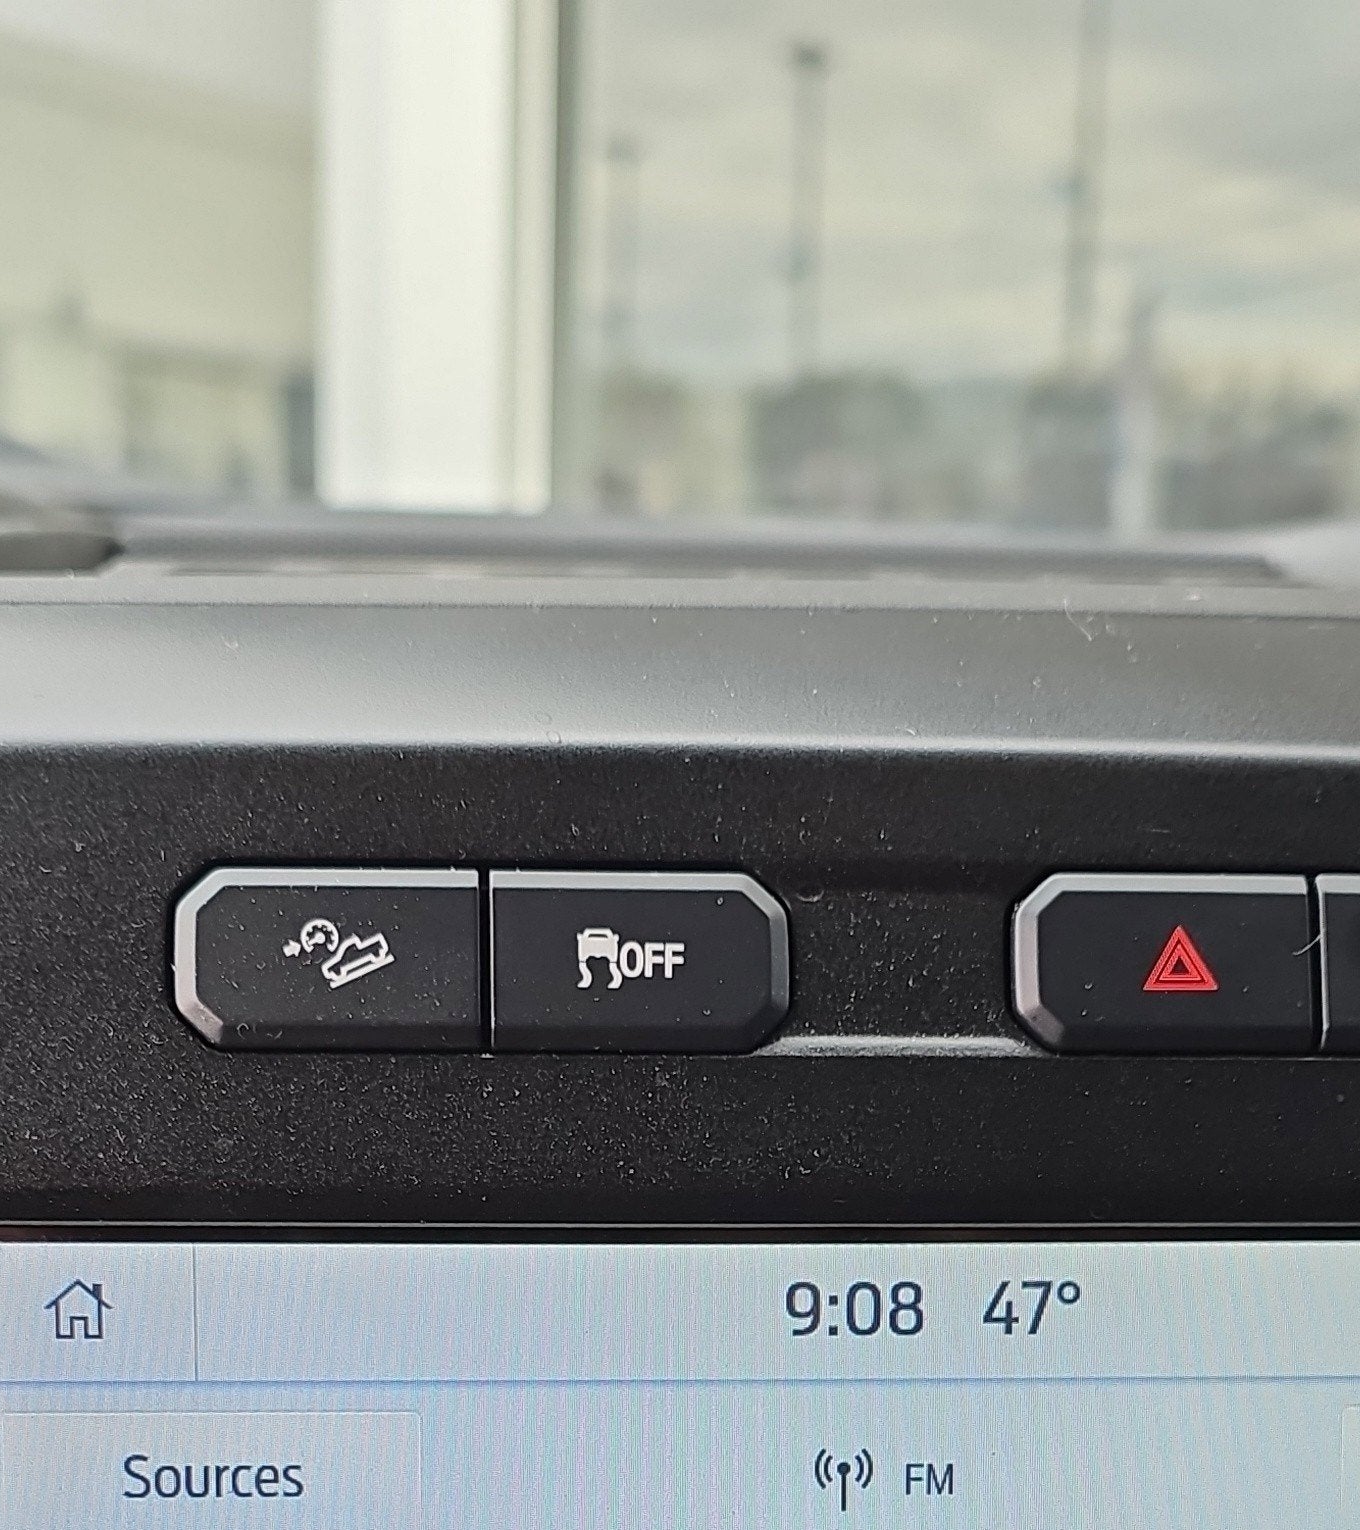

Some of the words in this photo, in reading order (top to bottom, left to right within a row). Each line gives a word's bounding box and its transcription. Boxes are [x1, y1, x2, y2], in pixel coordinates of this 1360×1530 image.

[620, 942, 684, 978] OFF
[786, 1281, 923, 1336] 9:08
[123, 1454, 303, 1498] Sources
[905, 1463, 954, 1494] FM
